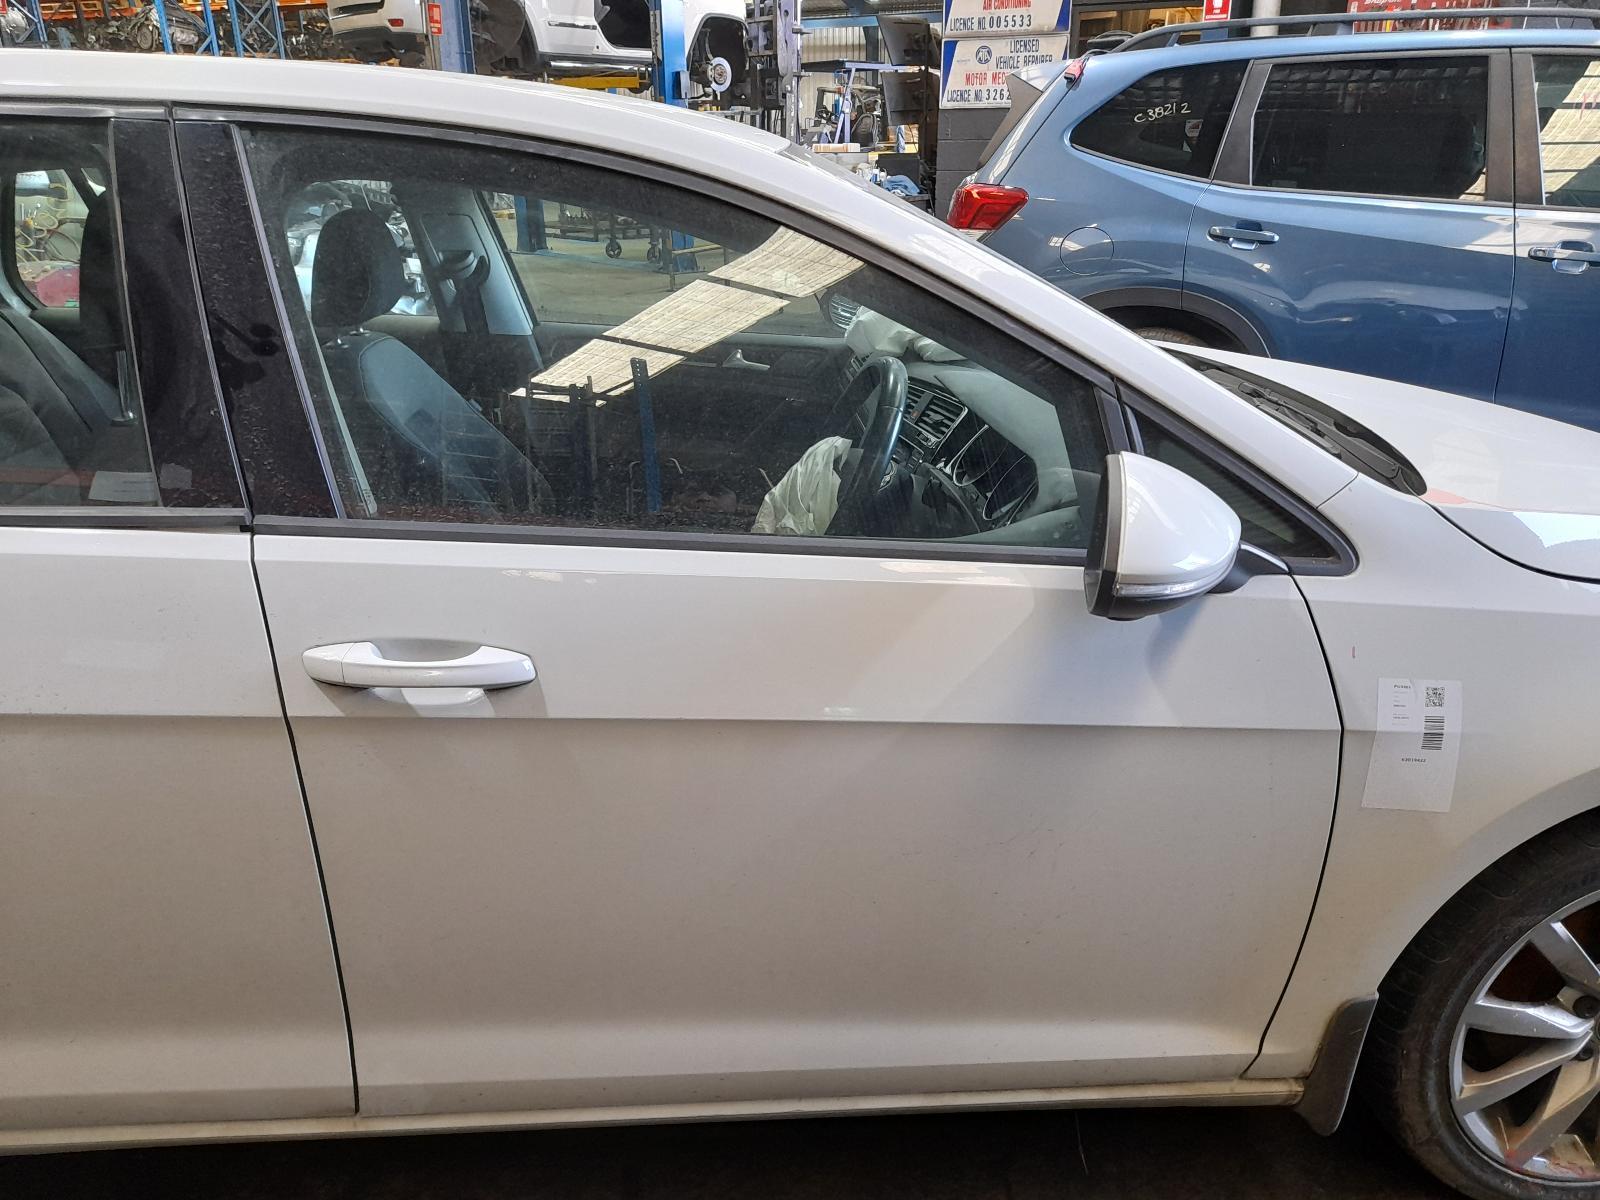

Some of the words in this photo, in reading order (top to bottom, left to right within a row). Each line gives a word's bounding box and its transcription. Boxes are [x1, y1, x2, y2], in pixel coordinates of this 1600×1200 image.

[950, 17, 975, 32] LICENCE
[989, 14, 1032, 28] 005533
[1009, 39, 1039, 53] LICENSED
[995, 56, 1020, 69] VEHICLE
[965, 72, 987, 86] MOTOR
[947, 89, 971, 102] LICENCE
